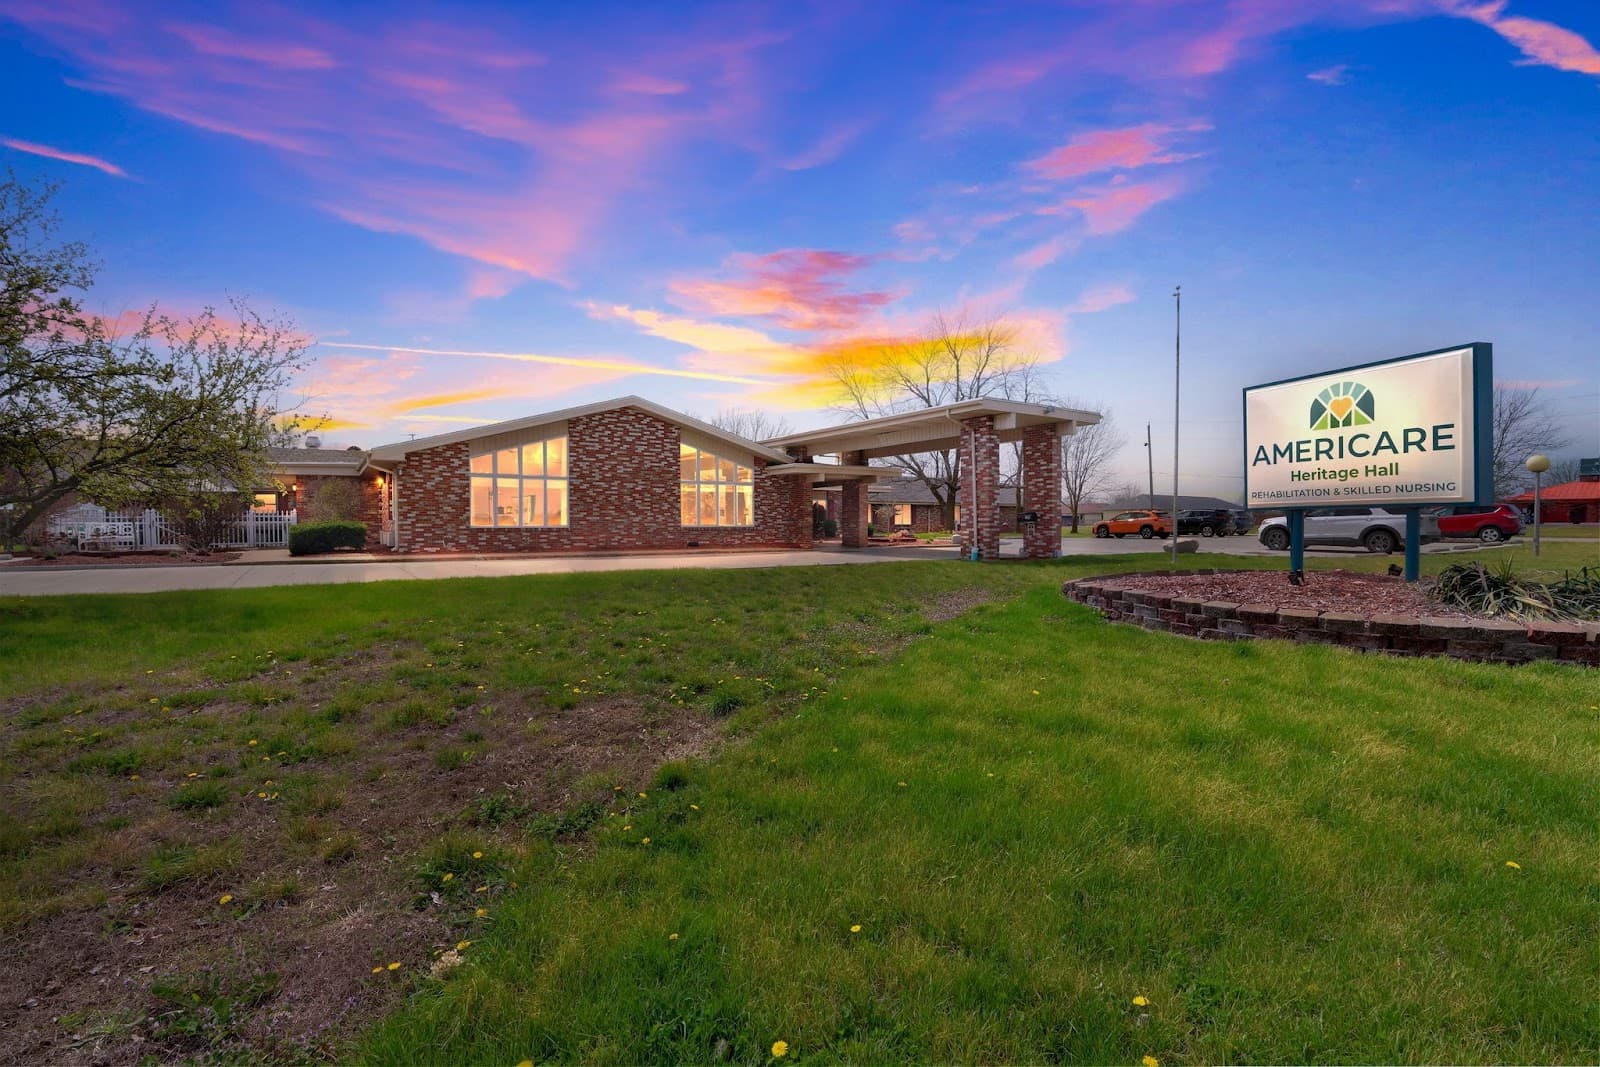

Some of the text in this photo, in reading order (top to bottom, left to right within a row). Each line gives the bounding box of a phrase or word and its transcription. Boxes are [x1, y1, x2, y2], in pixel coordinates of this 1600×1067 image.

[1252, 423, 1456, 466] AMERICARE
[1291, 463, 1399, 482] Heritage Hall
[1251, 482, 1456, 499] REHABILITATION & SKILLED NURSING
